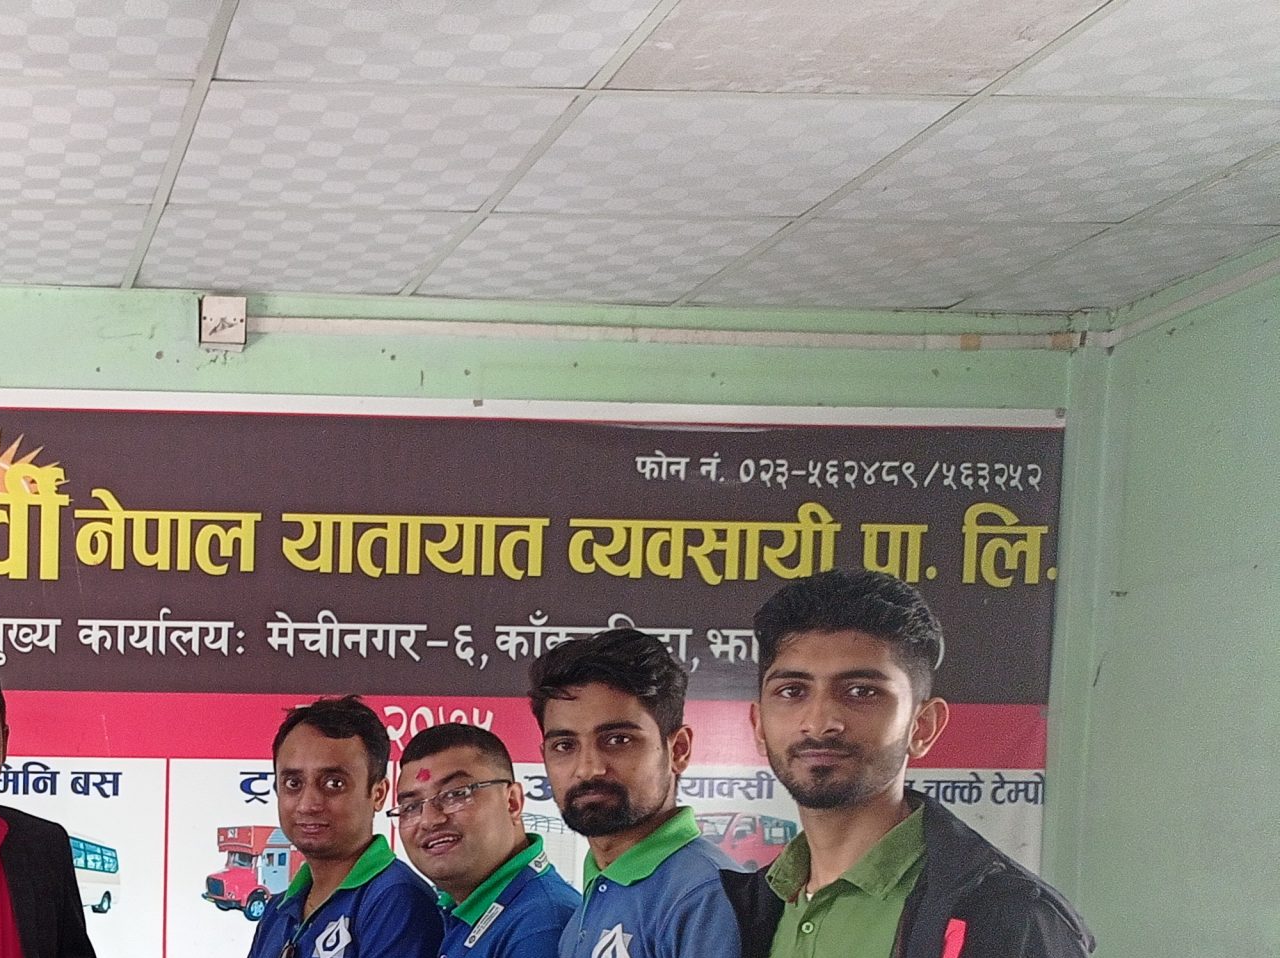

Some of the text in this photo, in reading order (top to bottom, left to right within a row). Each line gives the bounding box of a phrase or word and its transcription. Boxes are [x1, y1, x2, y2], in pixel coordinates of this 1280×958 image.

[635, 450, 689, 480] फोन
[700, 451, 725, 482] नं.
[74, 489, 262, 576] नेपाल
[282, 513, 550, 580] यातायात
[569, 502, 842, 586] व्यवसायी
[962, 502, 1057, 588] लि.
[70, 772, 123, 798] बस
